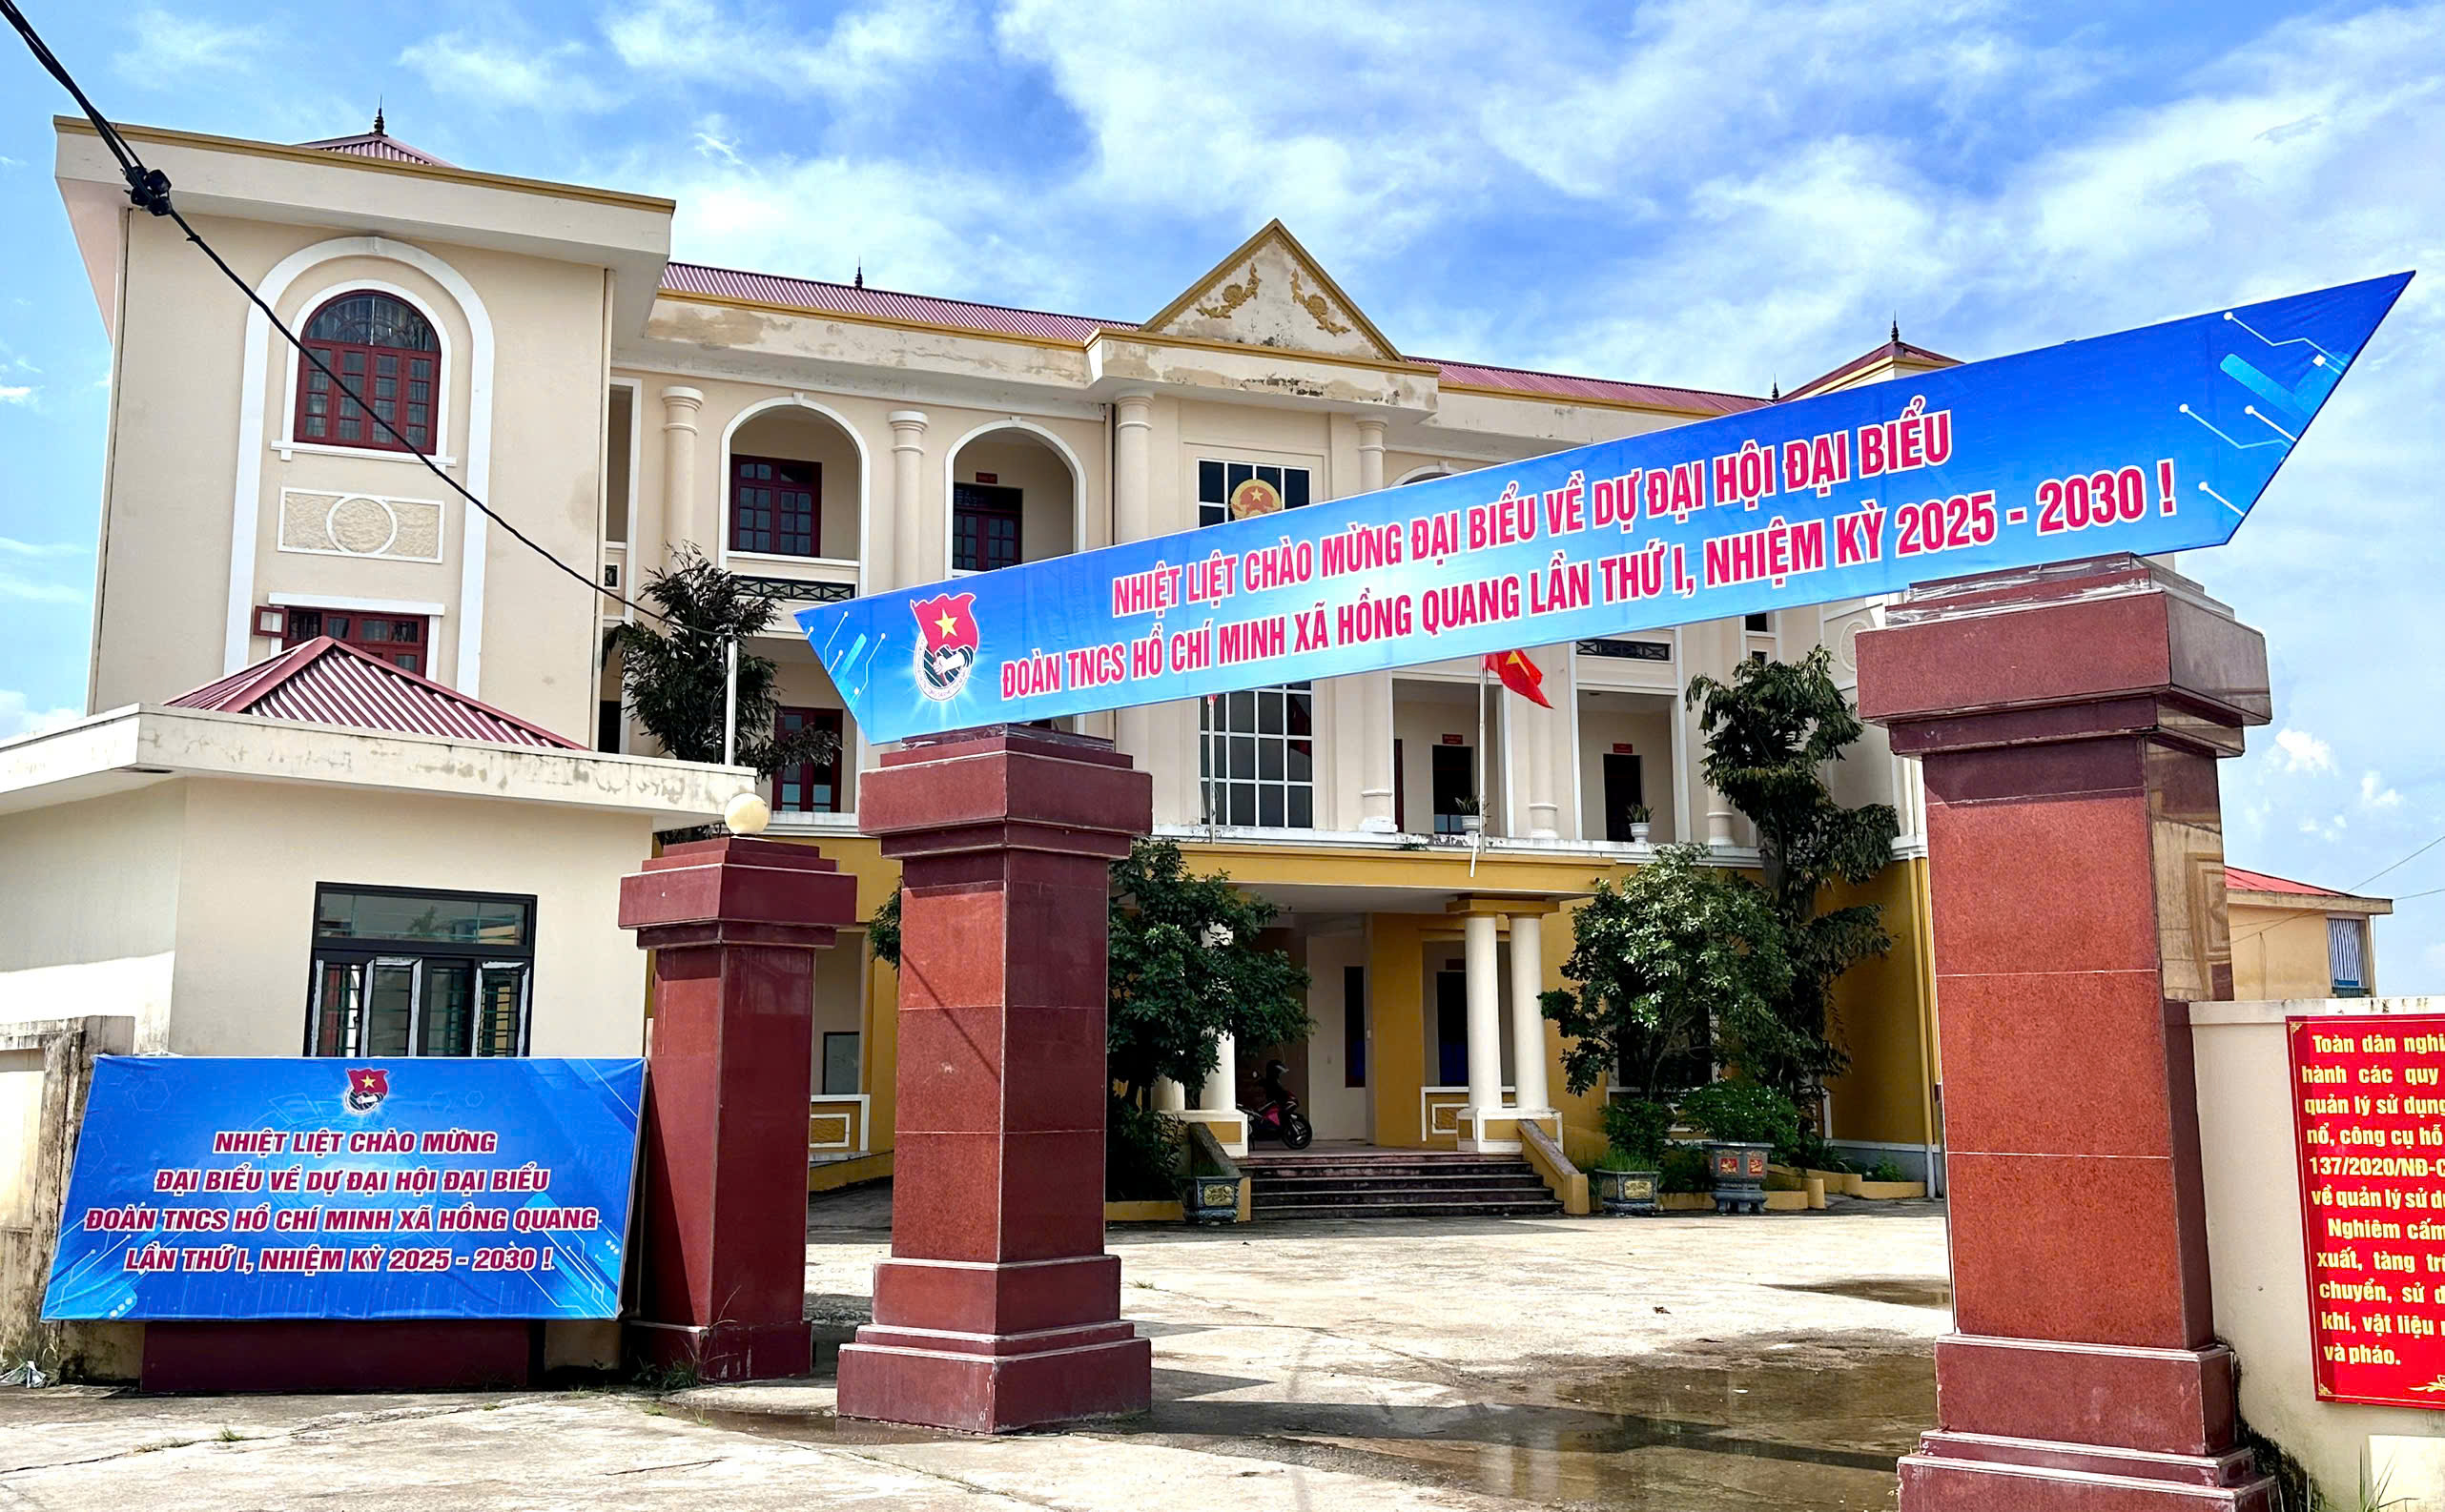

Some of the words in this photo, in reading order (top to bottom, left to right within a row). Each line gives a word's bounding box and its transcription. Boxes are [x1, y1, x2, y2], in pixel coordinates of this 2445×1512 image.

[1112, 561, 1182, 618] NHIỆT
[1185, 550, 1238, 607] LIỆT
[1243, 537, 1314, 593] CHÀO
[1320, 522, 1404, 579] MỪNG
[1409, 511, 1460, 566] ĐẠI
[1467, 480, 1537, 551] BIỂU
[1543, 472, 1585, 536] VỀ
[1592, 469, 1642, 533] DỰ
[1646, 460, 1705, 522] ĐẠI
[1714, 440, 1776, 510] HỘI
[1783, 432, 1849, 497] ĐẠI
[1858, 396, 1951, 478] BIỂU
[1000, 654, 1062, 701] ĐOÀN
[1066, 643, 1126, 690] TNCS
[1131, 623, 1164, 680] HỒ
[1169, 621, 1212, 673] CHÍ
[1217, 615, 1287, 665] MINH
[1292, 601, 1331, 655] XÃ
[1336, 587, 1413, 647] HỒNG
[1420, 574, 1522, 638] QUANG
[1529, 550, 1592, 616] LẦN
[1598, 540, 1667, 604] THỨ
[1672, 544, 1695, 596] I,
[1704, 517, 1825, 587] NHIỆM
[1835, 500, 1885, 566] KỲ
[1896, 491, 1997, 557] 2025
[2007, 509, 2025, 523] -
[2037, 466, 2146, 534] 2030
[2158, 460, 2175, 516] !
[2311, 1034, 2355, 1053] Toàn
[2361, 1033, 2396, 1053] dân
[2301, 1064, 2347, 1084] hành
[2358, 1064, 2394, 1084] các
[2404, 1068, 2439, 1086] quy
[2304, 1093, 2350, 1115] quản
[2353, 1094, 2371, 1116] lý
[2375, 1093, 2399, 1114] sử
[214, 1130, 287, 1156] NHIỆT
[292, 1128, 344, 1157] LIỆT
[349, 1129, 416, 1154] CHÀO
[422, 1129, 498, 1154] MỪNG
[2307, 1122, 2335, 1147] nổ,
[2339, 1126, 2386, 1148] công
[2391, 1130, 2414, 1150] cụ
[2418, 1123, 2443, 1146] hỗ
[154, 1170, 199, 1195] ĐẠI
[205, 1163, 263, 1193] BIỂU
[270, 1166, 300, 1192] VỀ
[306, 1169, 344, 1195] DỰ
[345, 1171, 389, 1195] ĐẠI
[396, 1169, 439, 1195] HỘI
[442, 1171, 487, 1195] ĐẠI
[491, 1163, 551, 1192] BIỂU
[2311, 1183, 2333, 1206] về
[2335, 1185, 2382, 1209] quản
[2384, 1188, 2402, 1210] lý
[2404, 1187, 2428, 1209] sử
[85, 1205, 157, 1232] ĐOÀN
[164, 1209, 230, 1232] TNCS
[234, 1203, 269, 1232] HỒ
[276, 1205, 322, 1232] CHÍ
[324, 1210, 393, 1232] MINH
[398, 1205, 433, 1232] XÃ
[439, 1202, 508, 1232] HỒNG
[514, 1208, 598, 1233] QUANG
[2327, 1217, 2401, 1240] Nghiêm
[2406, 1217, 2445, 1240] cấm
[124, 1242, 177, 1272] LẦN
[184, 1245, 235, 1273] THỨ
[236, 1250, 254, 1274] I,
[259, 1243, 345, 1277] NHIỆM
[350, 1245, 384, 1272] KỲ
[388, 1249, 452, 1272] 2025
[457, 1256, 469, 1265] -
[472, 1248, 537, 1271] 2030
[543, 1248, 553, 1270] !
[2316, 1246, 2363, 1272] xuất,
[2373, 1250, 2415, 1274] tàng
[2319, 1277, 2393, 1304] chuyển,
[2401, 1281, 2425, 1303] sử
[2321, 1311, 2356, 1334] khí,
[2361, 1313, 2393, 1337] vật
[2396, 1315, 2435, 1339] liệu
[2323, 1342, 2346, 1362] và
[2348, 1344, 2401, 1365] pháo.
